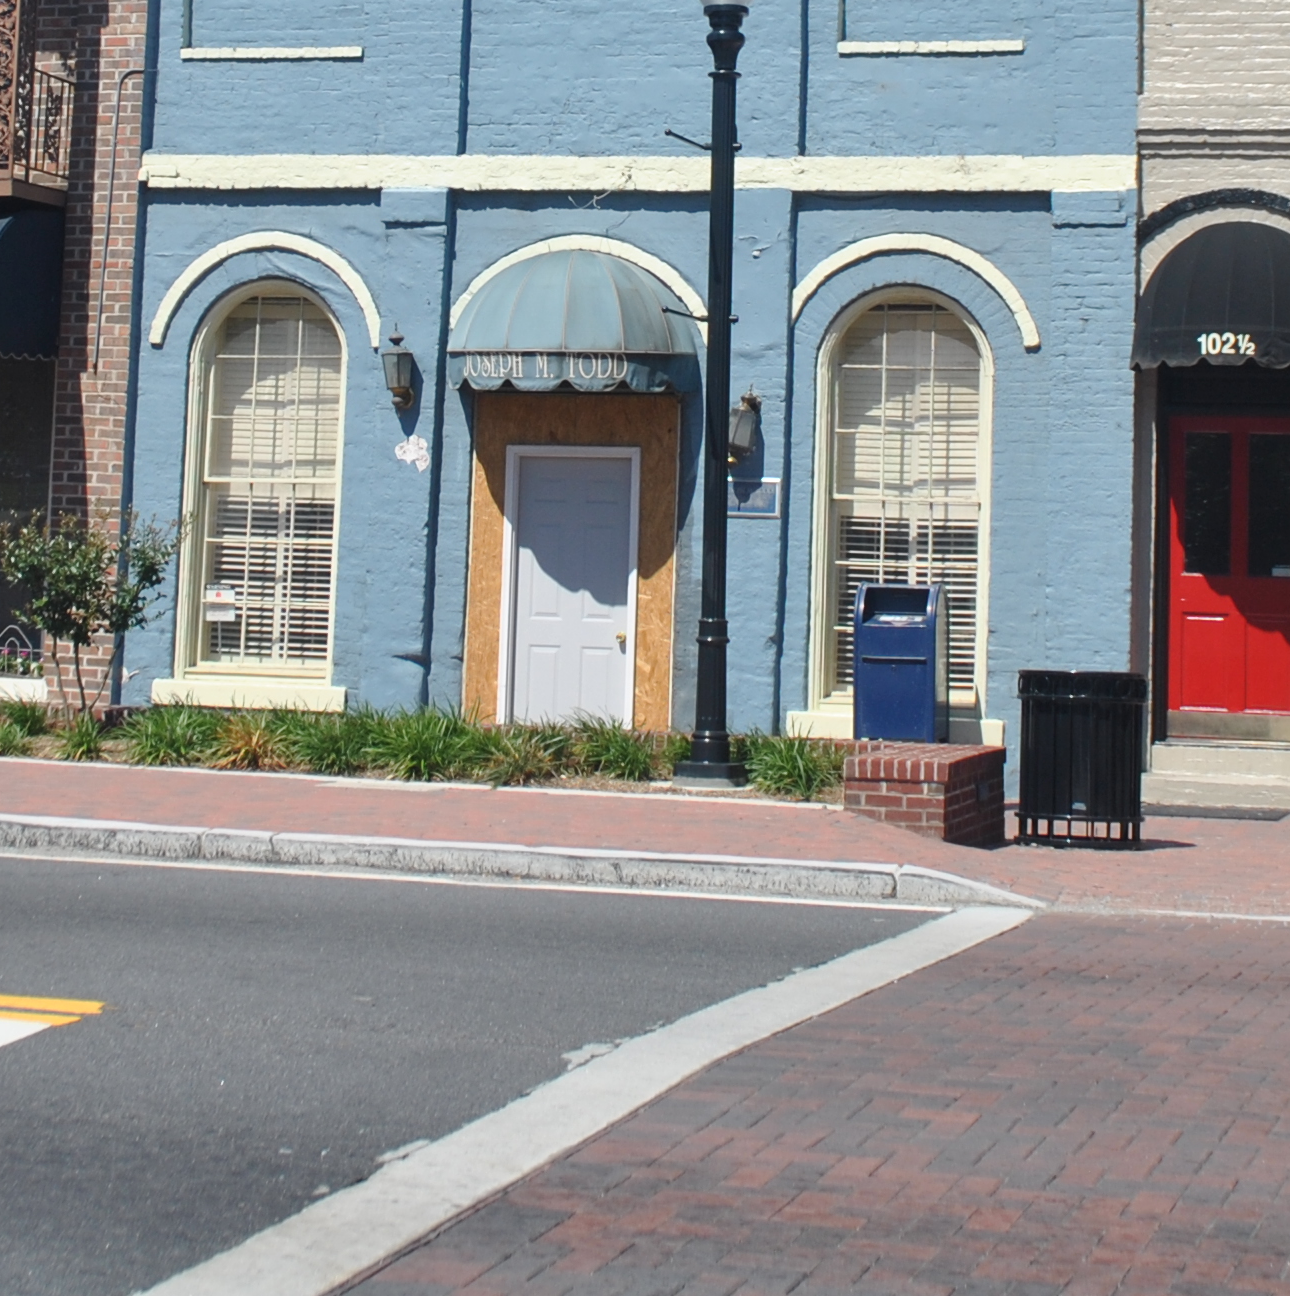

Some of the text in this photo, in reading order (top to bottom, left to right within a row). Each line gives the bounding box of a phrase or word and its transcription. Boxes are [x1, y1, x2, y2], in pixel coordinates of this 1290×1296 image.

[463, 351, 628, 379] JOSEPH M. TODD
